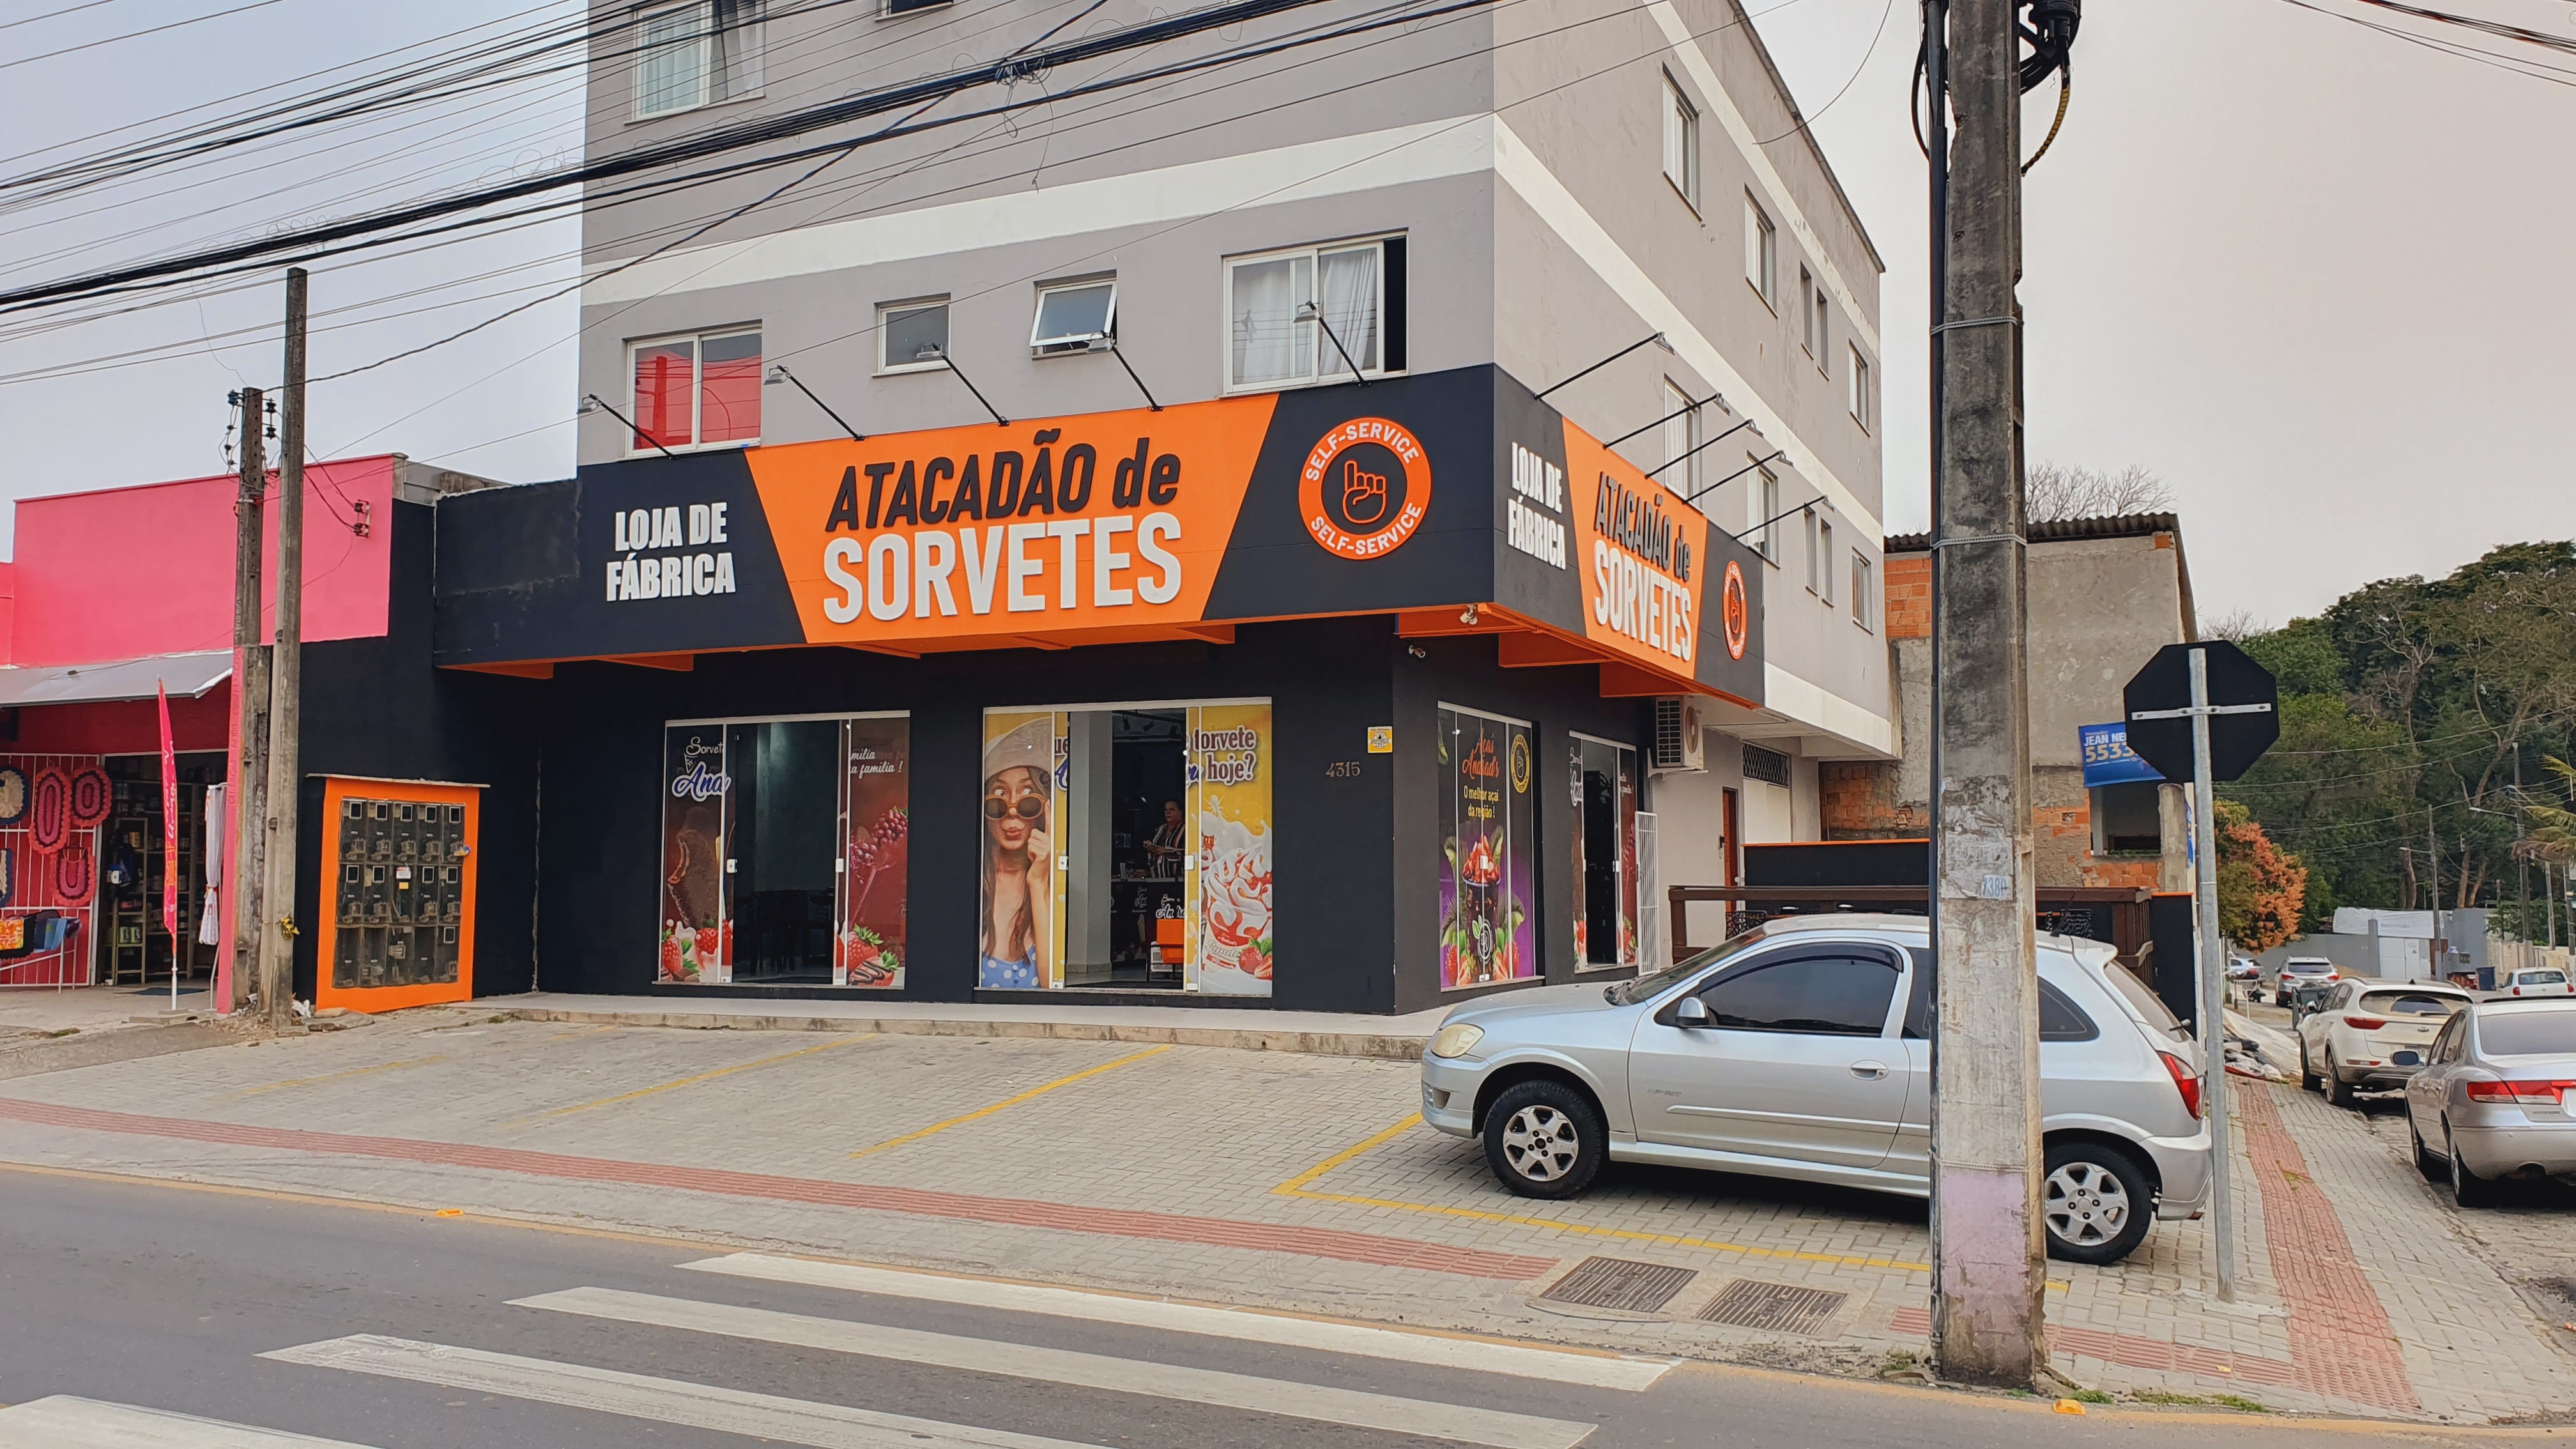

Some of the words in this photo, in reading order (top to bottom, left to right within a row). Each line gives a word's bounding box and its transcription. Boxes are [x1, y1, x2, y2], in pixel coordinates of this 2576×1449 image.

[1306, 422, 1420, 481] SELF-SERVICE
[825, 429, 1096, 532] ATACADÃO
[1112, 437, 1180, 509] de
[1512, 441, 1544, 503] LOJA
[1545, 462, 1562, 514] DE
[616, 507, 683, 551] LOJA
[689, 502, 727, 546] DE
[1311, 502, 1422, 555] SELF-SERVICE
[1508, 495, 1566, 570] FÁBRICA
[1593, 471, 1672, 571] ATACADÃO
[1674, 525, 1690, 582] de
[607, 552, 735, 601] FÁBRICA
[824, 512, 1181, 624] SORVETES
[1593, 539, 1691, 662] SORVETES
[686, 736, 723, 755] Sorvet
[2084, 735, 2108, 746] JEAN
[1208, 751, 1254, 784] hoje?
[1325, 762, 1360, 778] 4315
[1464, 785, 1468, 799] O
[1469, 786, 1487, 801] melhor
[1468, 803, 1475, 816] da
